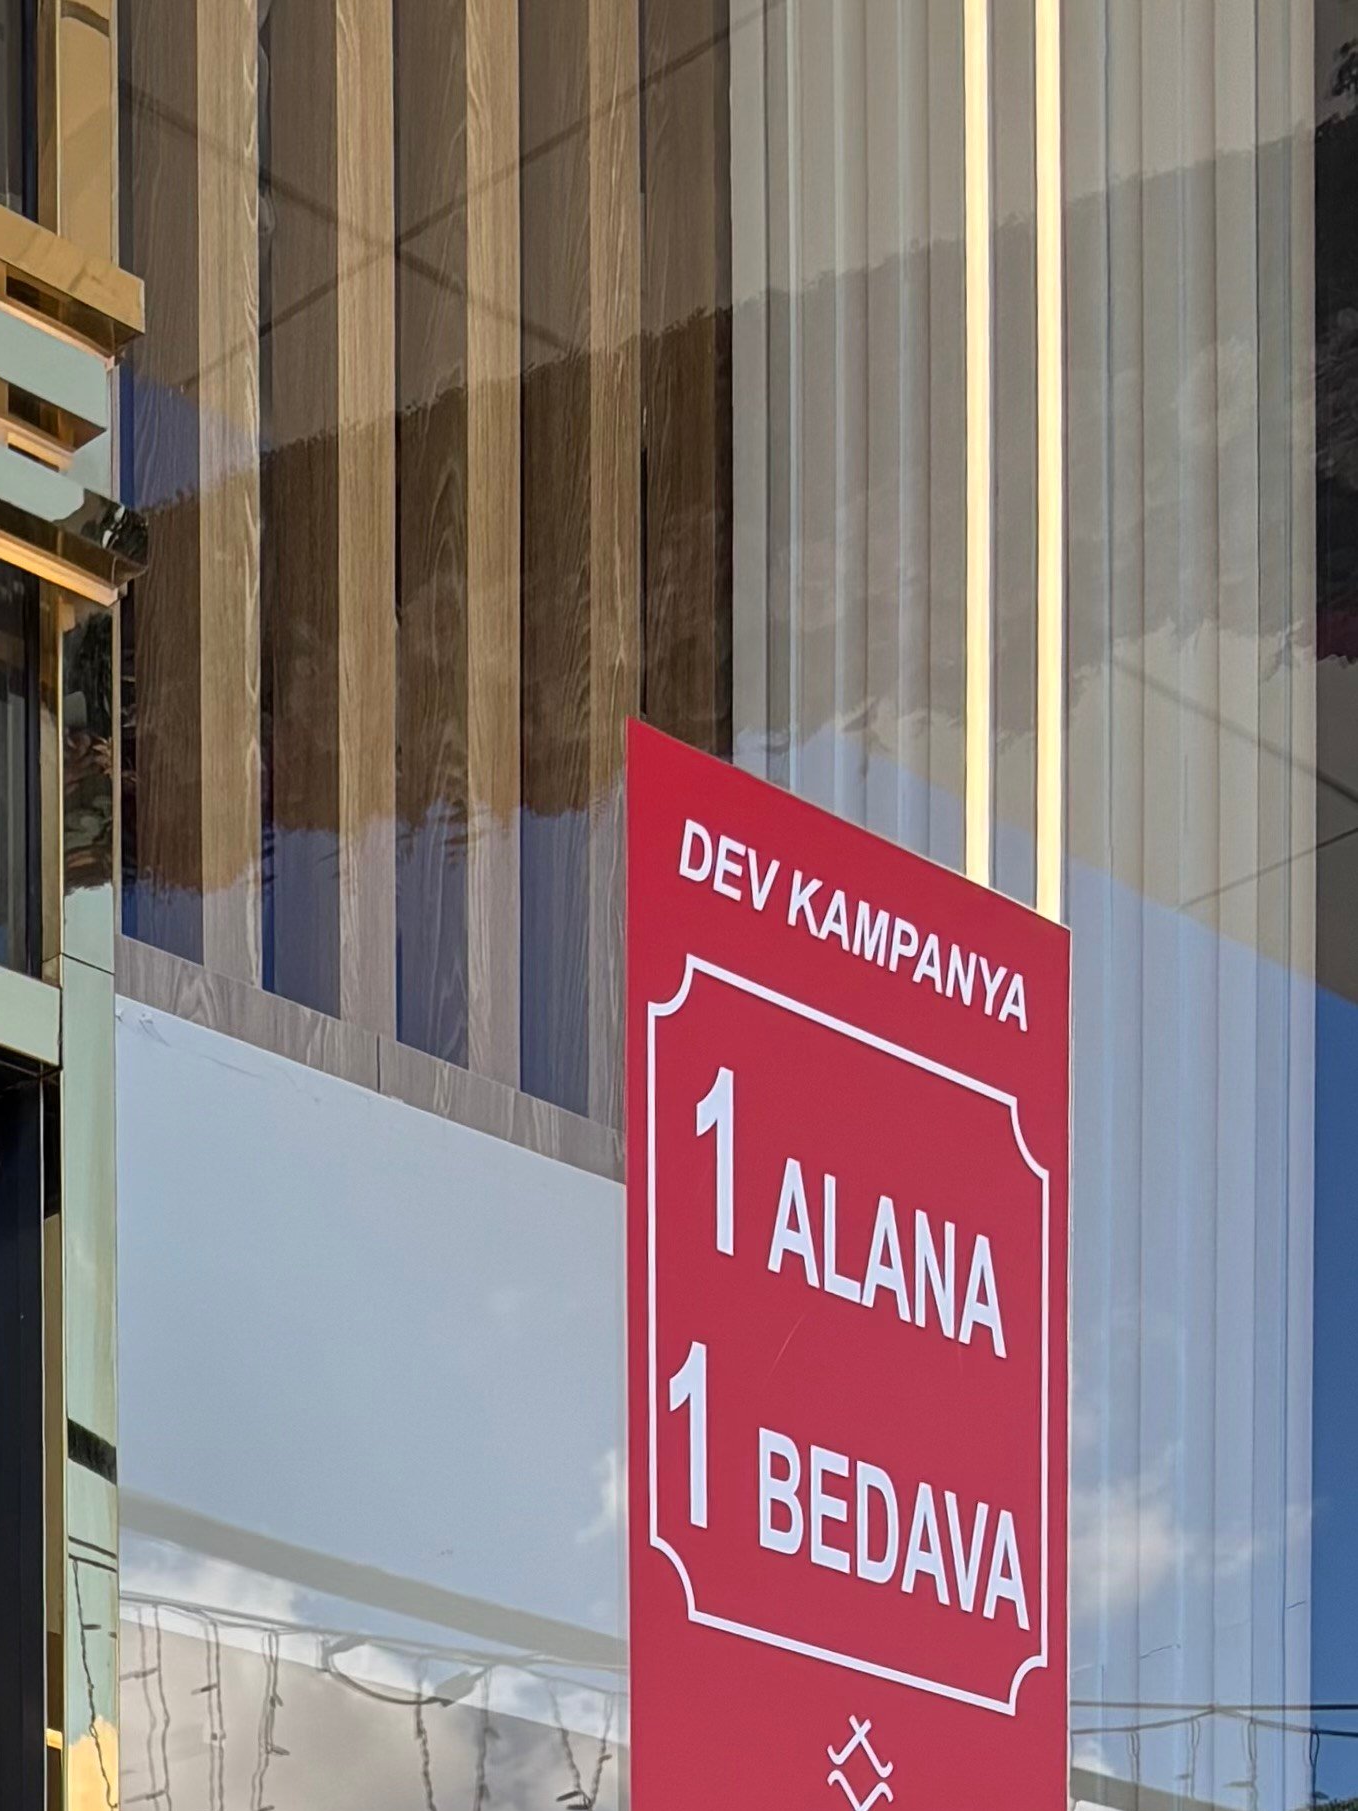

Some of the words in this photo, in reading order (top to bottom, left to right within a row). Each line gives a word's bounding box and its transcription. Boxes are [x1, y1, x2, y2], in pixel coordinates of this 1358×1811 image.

[678, 818, 781, 912] DEV
[787, 868, 1029, 1033] KAMPANYA
[695, 1066, 734, 1257] 1
[766, 1156, 1008, 1360] ALANA
[668, 1340, 708, 1530] 1
[757, 1426, 1031, 1632] BEDAVA
